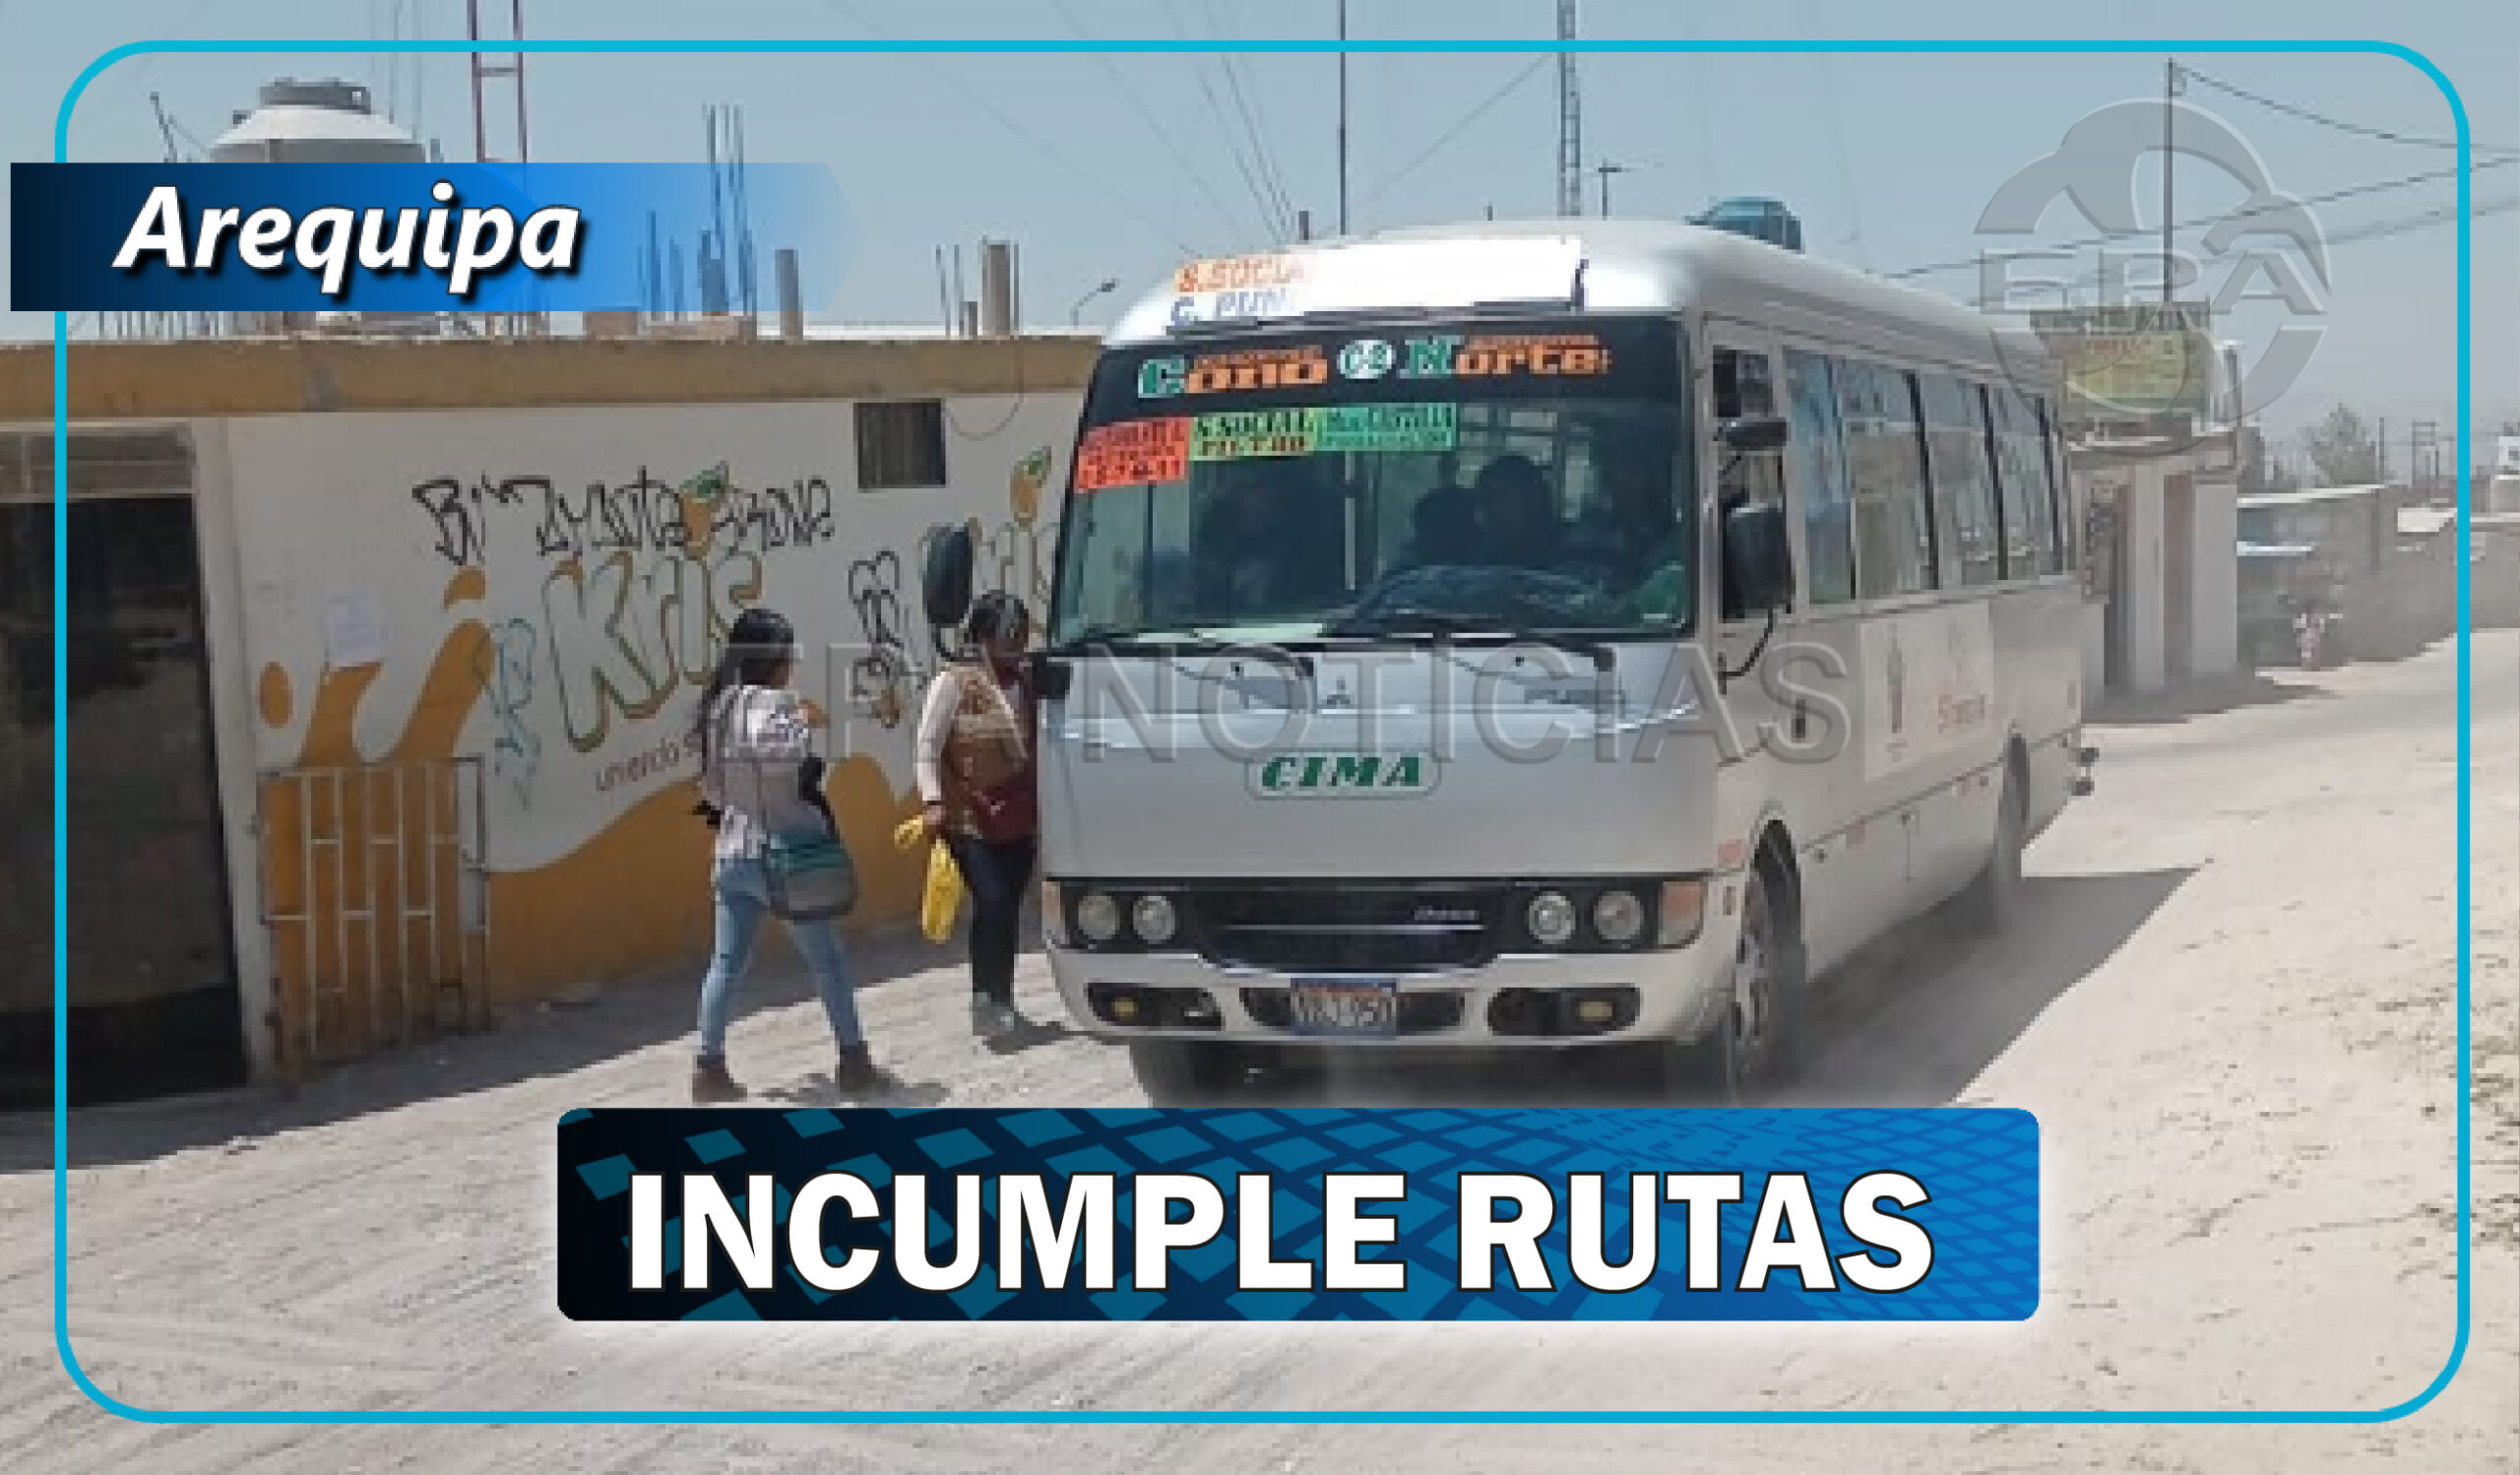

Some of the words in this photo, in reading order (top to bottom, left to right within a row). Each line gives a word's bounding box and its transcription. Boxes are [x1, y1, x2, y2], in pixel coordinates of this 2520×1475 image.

[1137, 352, 1328, 399] Cono
[1398, 334, 1602, 379] Norte
[1261, 755, 1422, 792] CIMA
